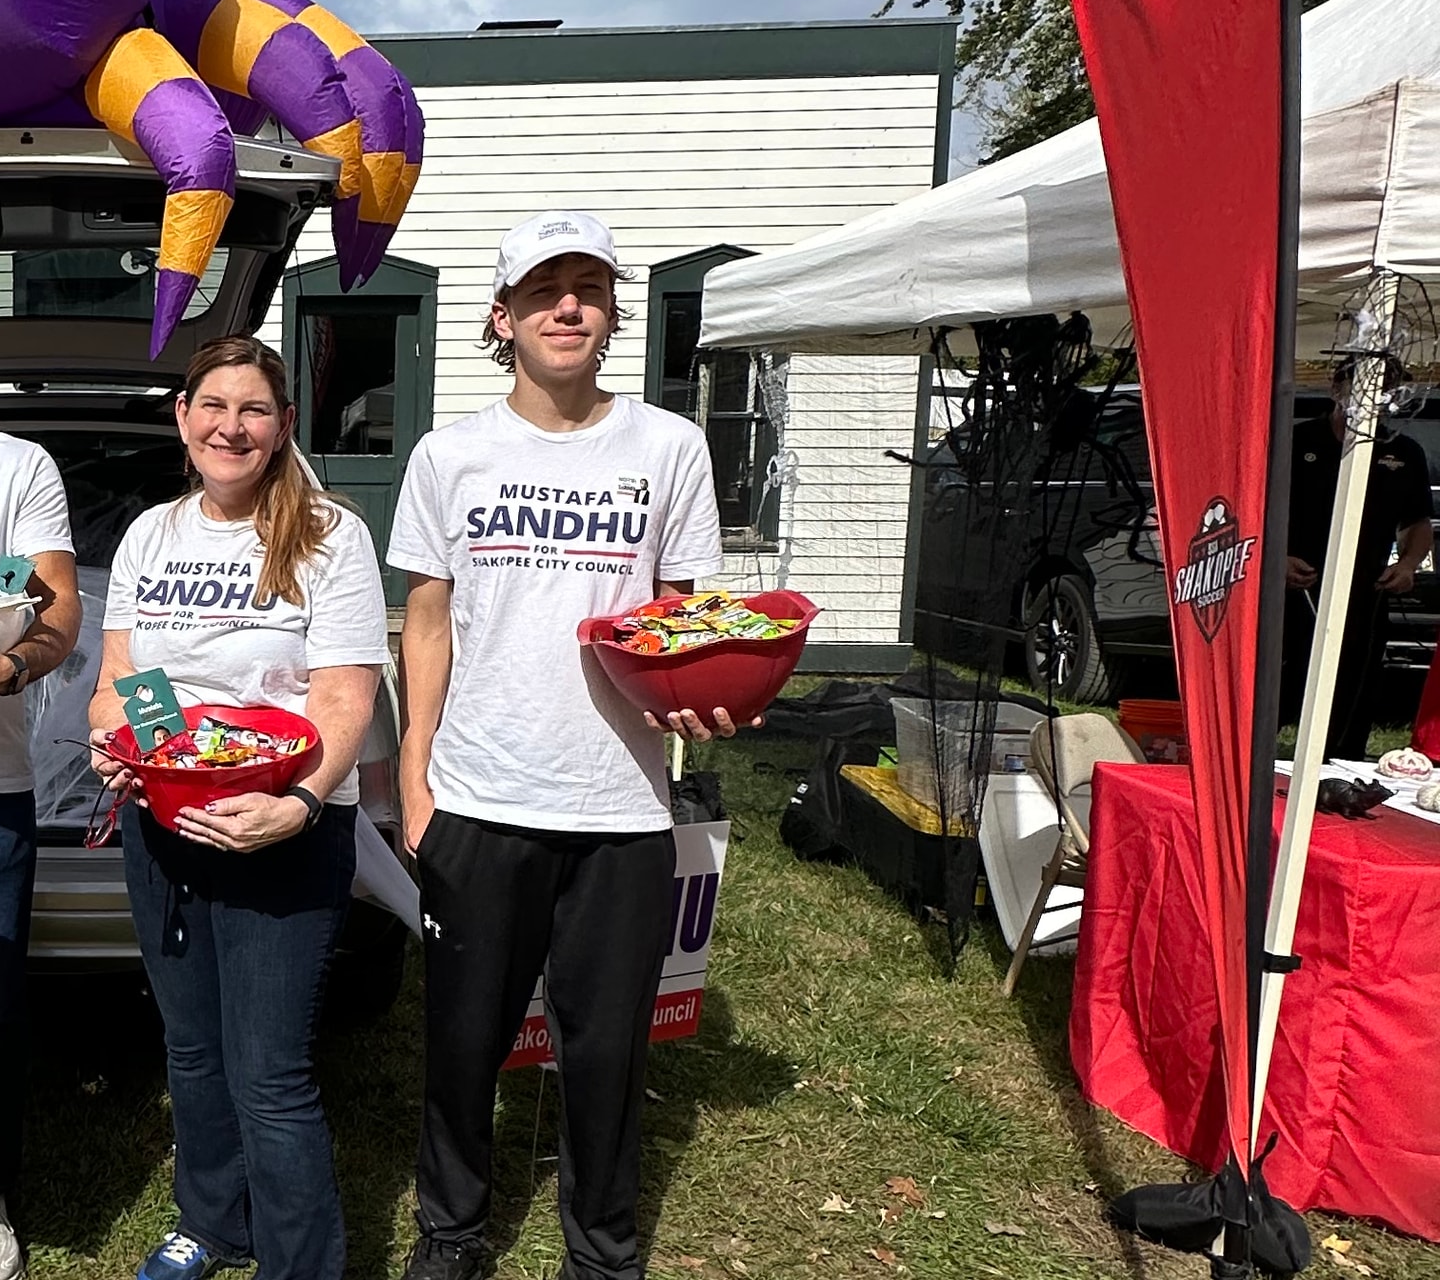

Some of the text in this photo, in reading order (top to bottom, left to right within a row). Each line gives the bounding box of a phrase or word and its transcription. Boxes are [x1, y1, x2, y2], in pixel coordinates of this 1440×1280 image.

[500, 483, 614, 506] MUSTAFA
[467, 505, 648, 545] SANDHU
[533, 544, 559, 556] FOR
[164, 560, 252, 577] MUSTAFA
[536, 558, 571, 571] CITY
[1175, 538, 1255, 605] SHAKOPEE
[1197, 588, 1226, 608] SOCCER
[652, 996, 697, 1026] uncil
